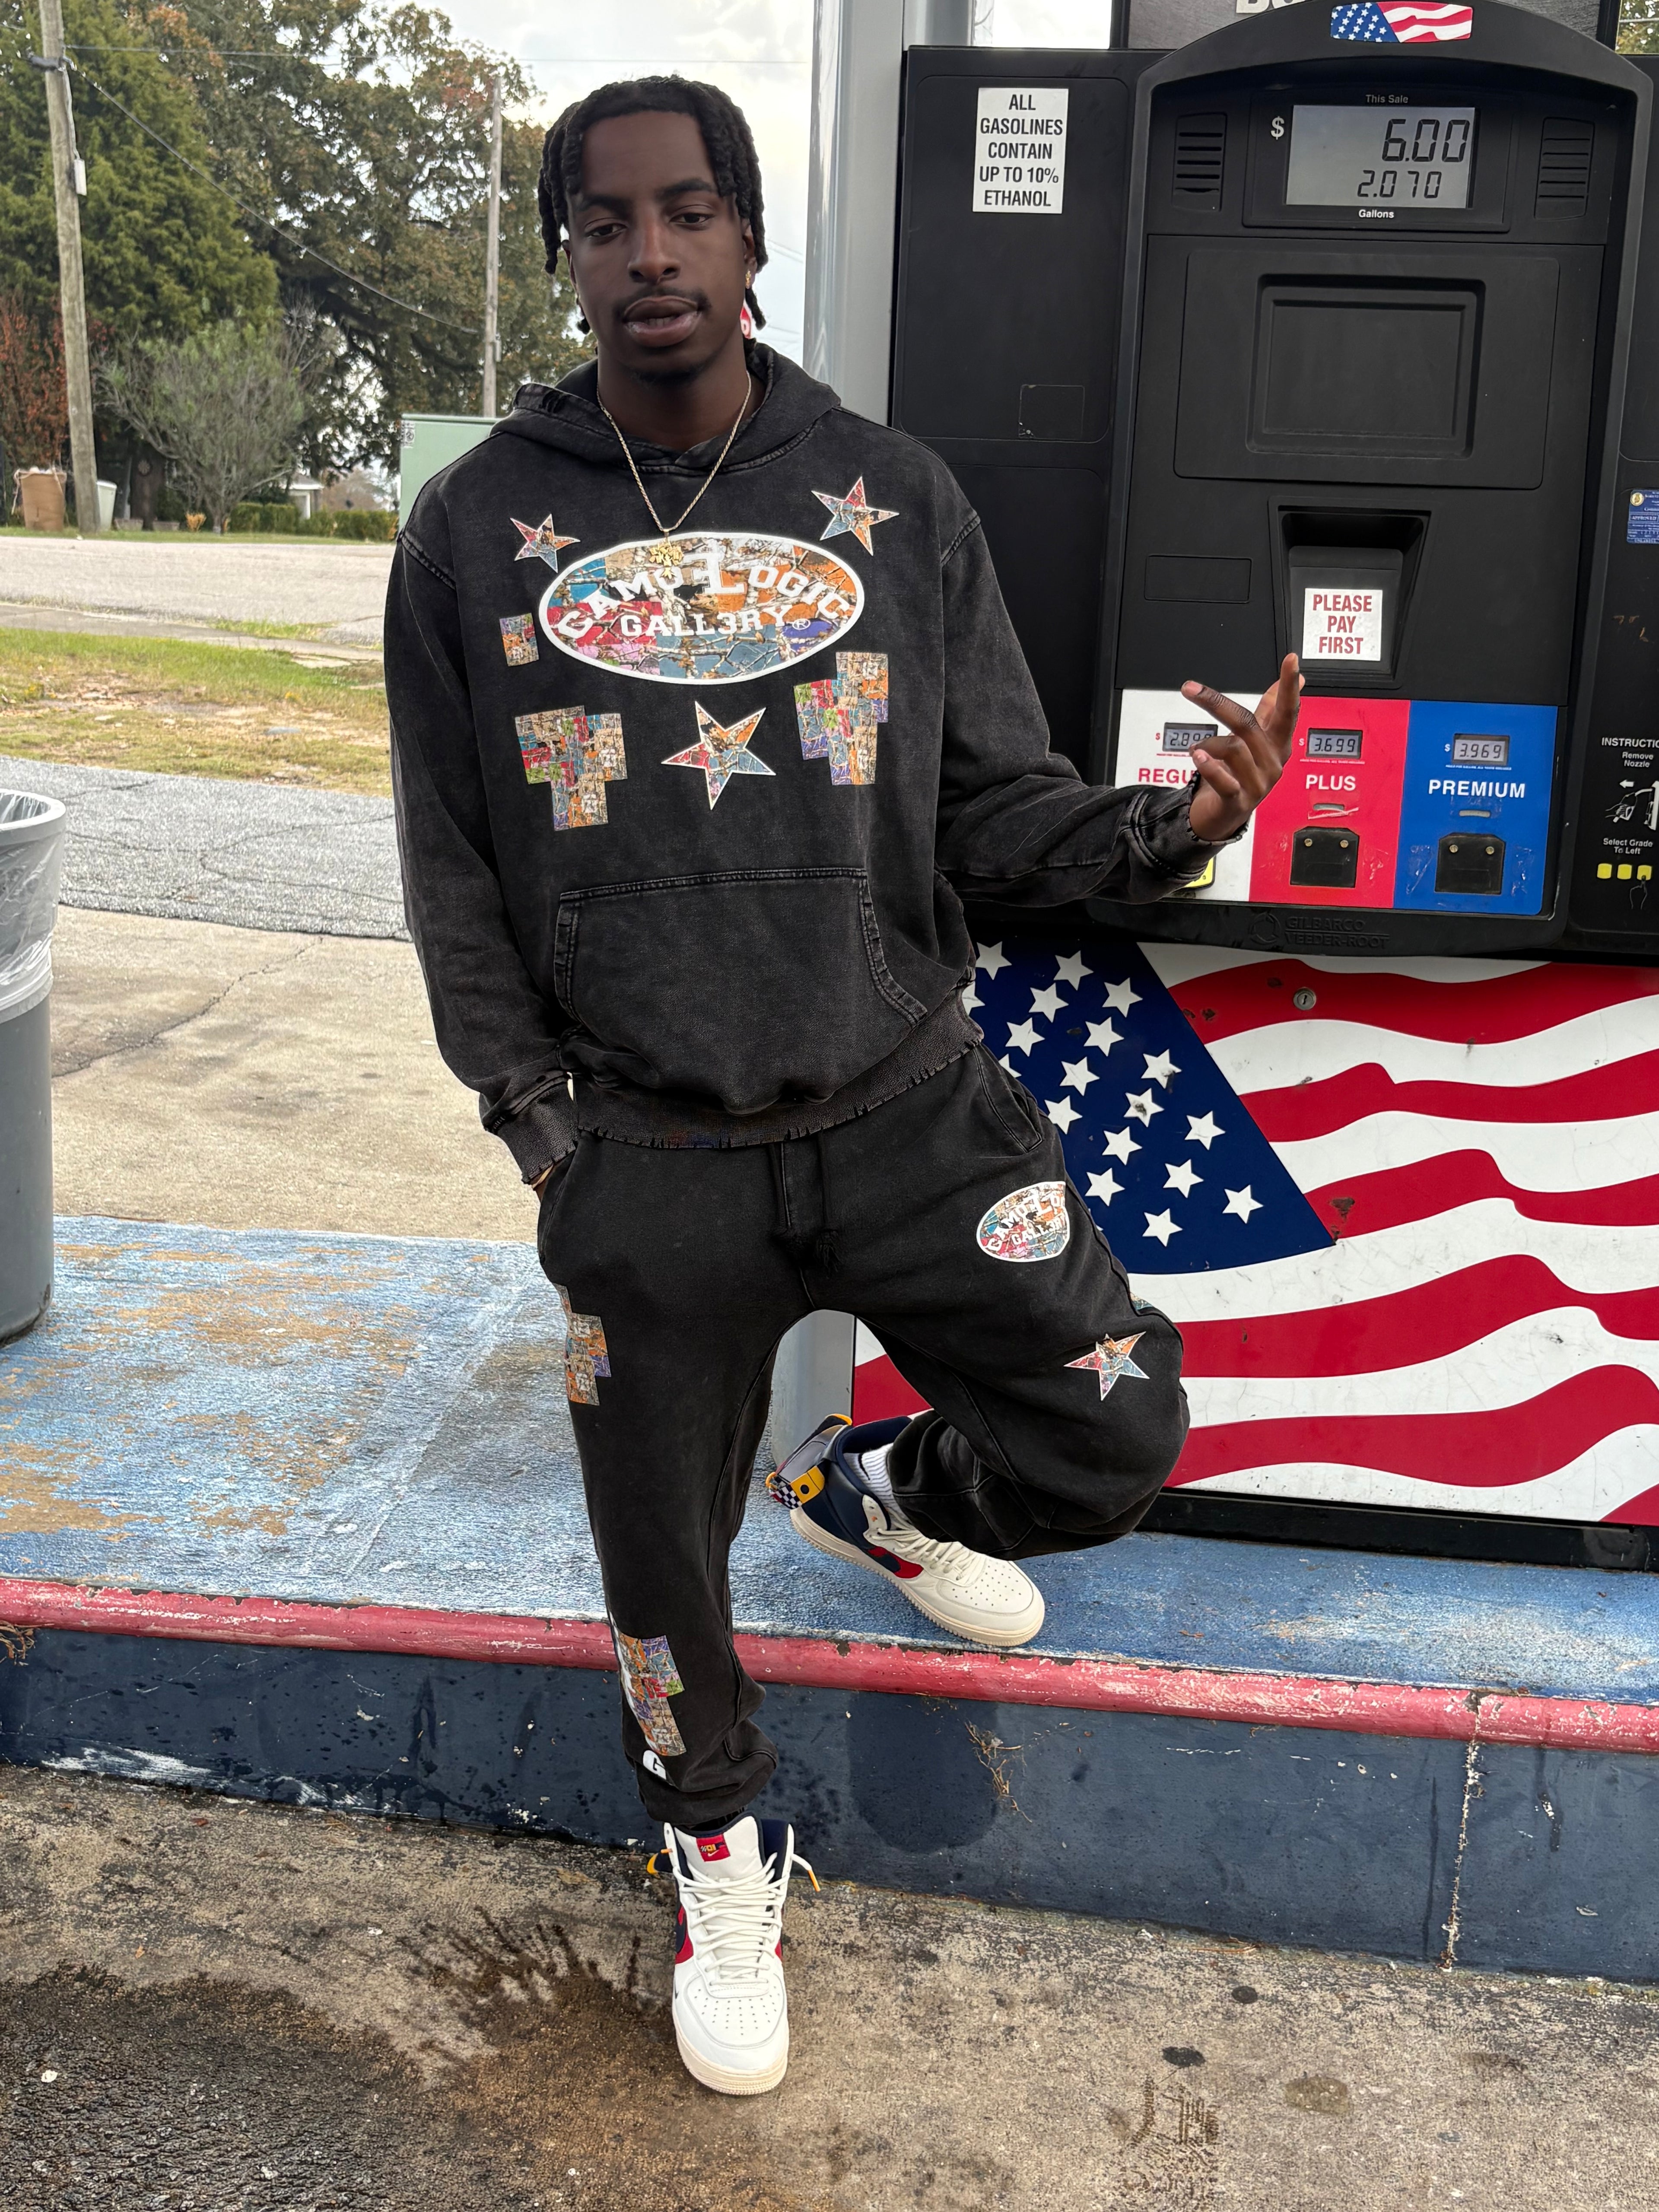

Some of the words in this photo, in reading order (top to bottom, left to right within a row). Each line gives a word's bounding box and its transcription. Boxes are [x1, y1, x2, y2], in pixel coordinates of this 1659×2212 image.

[1009, 94, 1036, 110] ALL
[1366, 95, 1385, 103] This
[1388, 95, 1408, 104] Sale
[980, 118, 1063, 136] GASOLINES
[1271, 116, 1284, 140] $
[1382, 119, 1470, 162] 6.00
[988, 142, 1052, 159] CONTAIN
[979, 166, 1000, 182] UP
[1003, 167, 1022, 183] TO
[1027, 167, 1059, 183] 10%
[1357, 170, 1442, 198] 2.070
[984, 190, 1051, 207] ETHANOL
[1358, 209, 1394, 219] Gallons
[1313, 594, 1372, 612] PLEASE
[1327, 615, 1357, 633] PAY
[1319, 636, 1363, 654] FIRST
[1314, 738, 1356, 752] 3.699
[1459, 744, 1502, 759] 3.969
[1622, 752, 1654, 760] Remove
[1138, 768, 1195, 785] REGU
[1306, 775, 1356, 791] PLUS
[1428, 779, 1526, 798] PREMIUM
[1630, 839, 1653, 847] Grade
[1286, 916, 1366, 931] GILBARCO
[1285, 932, 1389, 949] VEEDER-ROOT
